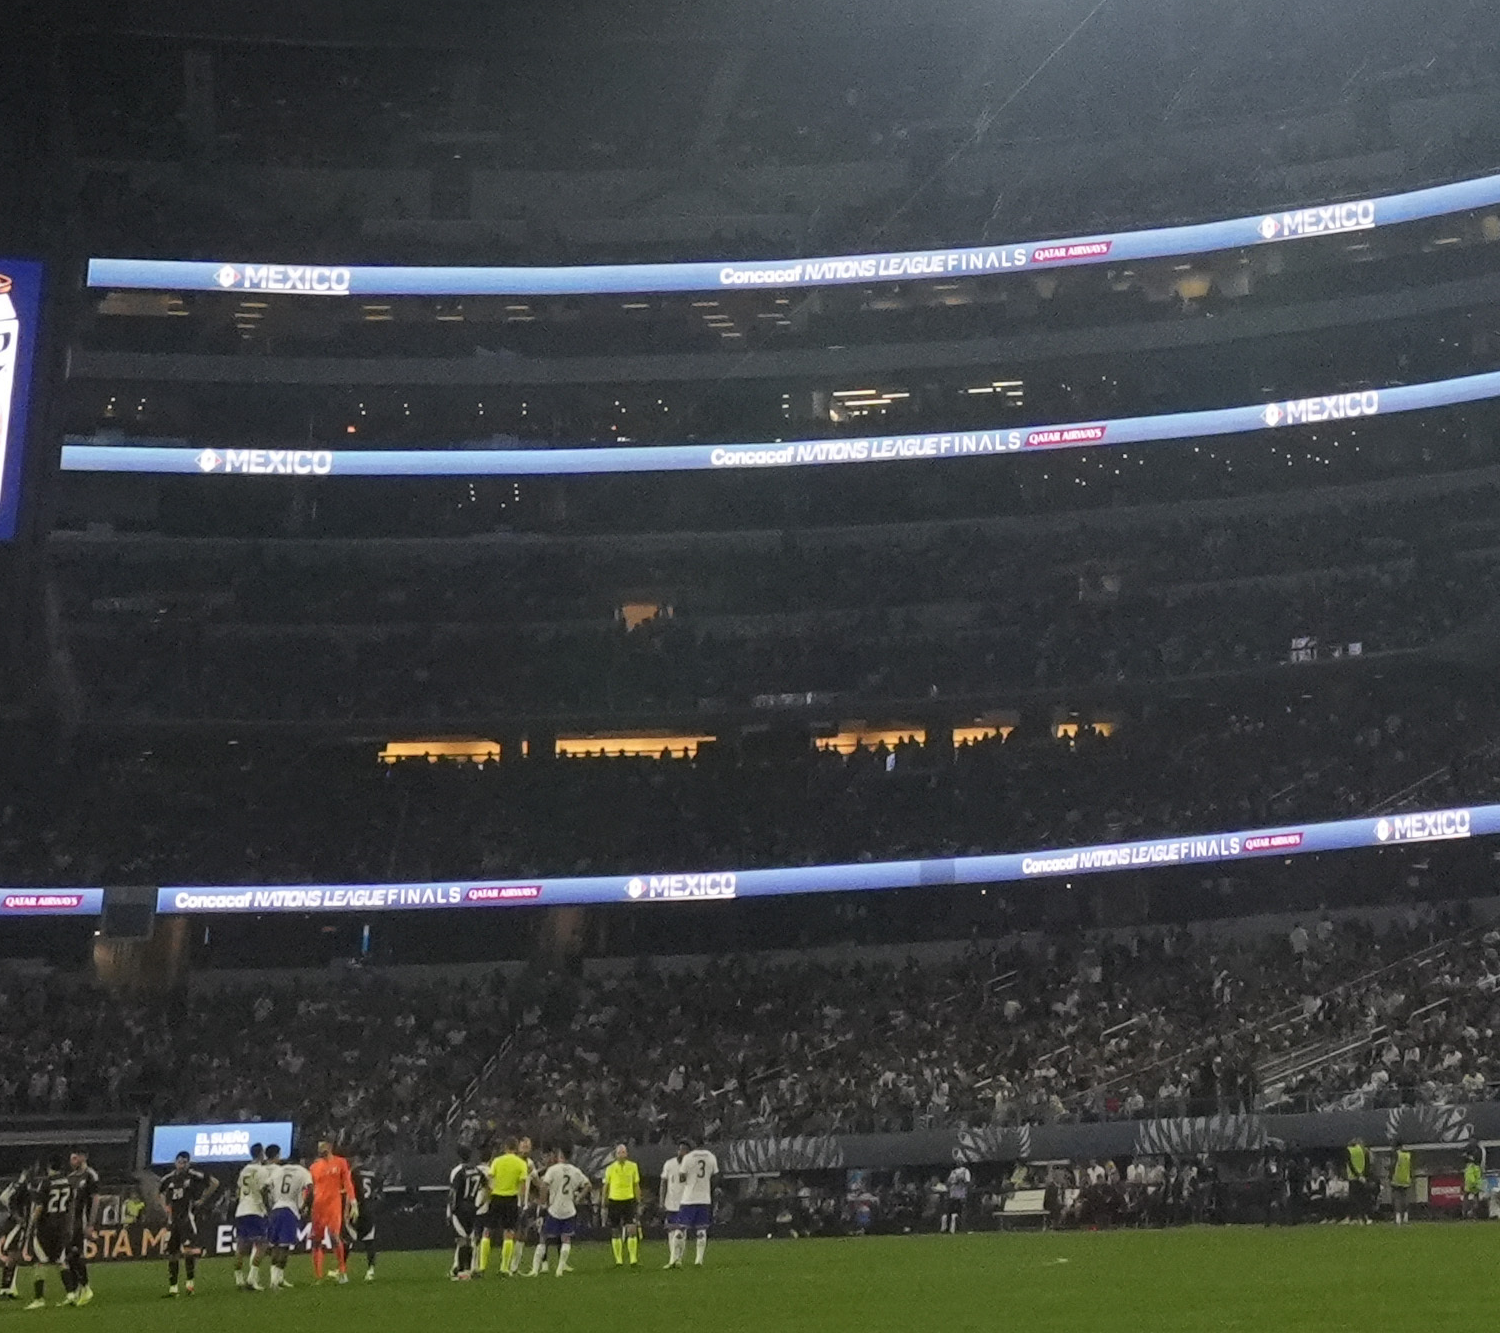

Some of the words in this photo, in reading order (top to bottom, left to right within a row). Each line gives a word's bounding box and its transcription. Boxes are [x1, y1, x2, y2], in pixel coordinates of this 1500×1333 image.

[196, 1133, 210, 1144] EL
[210, 1130, 250, 1144] SUEÑO
[194, 1144, 210, 1156] ES
[210, 1144, 250, 1156] AHORA
[697, 1160, 706, 1179] 3
[281, 1174, 293, 1194] 6
[464, 1175, 480, 1199] 17
[562, 1174, 571, 1195] 2
[48, 1187, 71, 1213] 22
